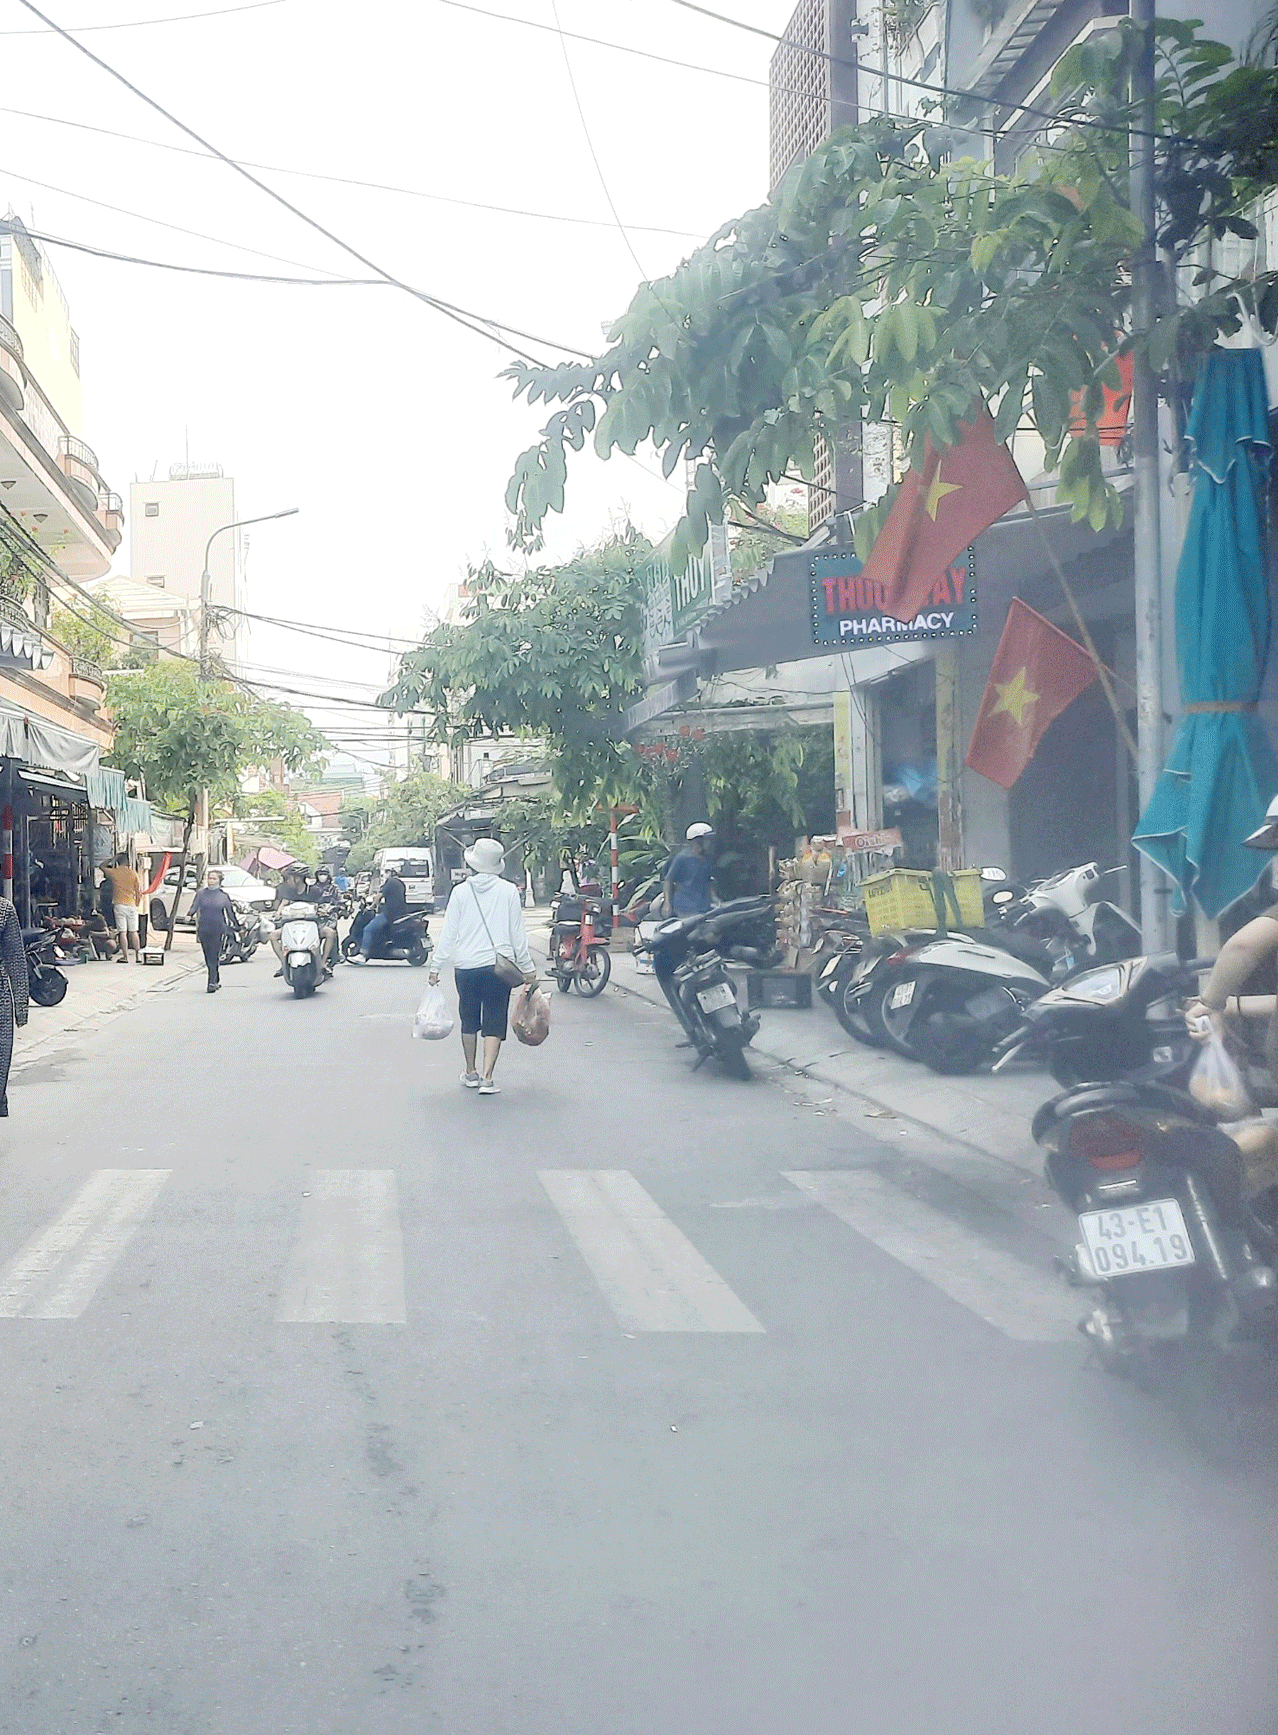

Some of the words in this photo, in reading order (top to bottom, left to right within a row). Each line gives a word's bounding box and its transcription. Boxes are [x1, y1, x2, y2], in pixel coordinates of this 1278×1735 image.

[839, 612, 954, 636] PHARMACY
[1097, 1206, 1167, 1240] 43-E1
[1094, 1233, 1187, 1272] 094.19
